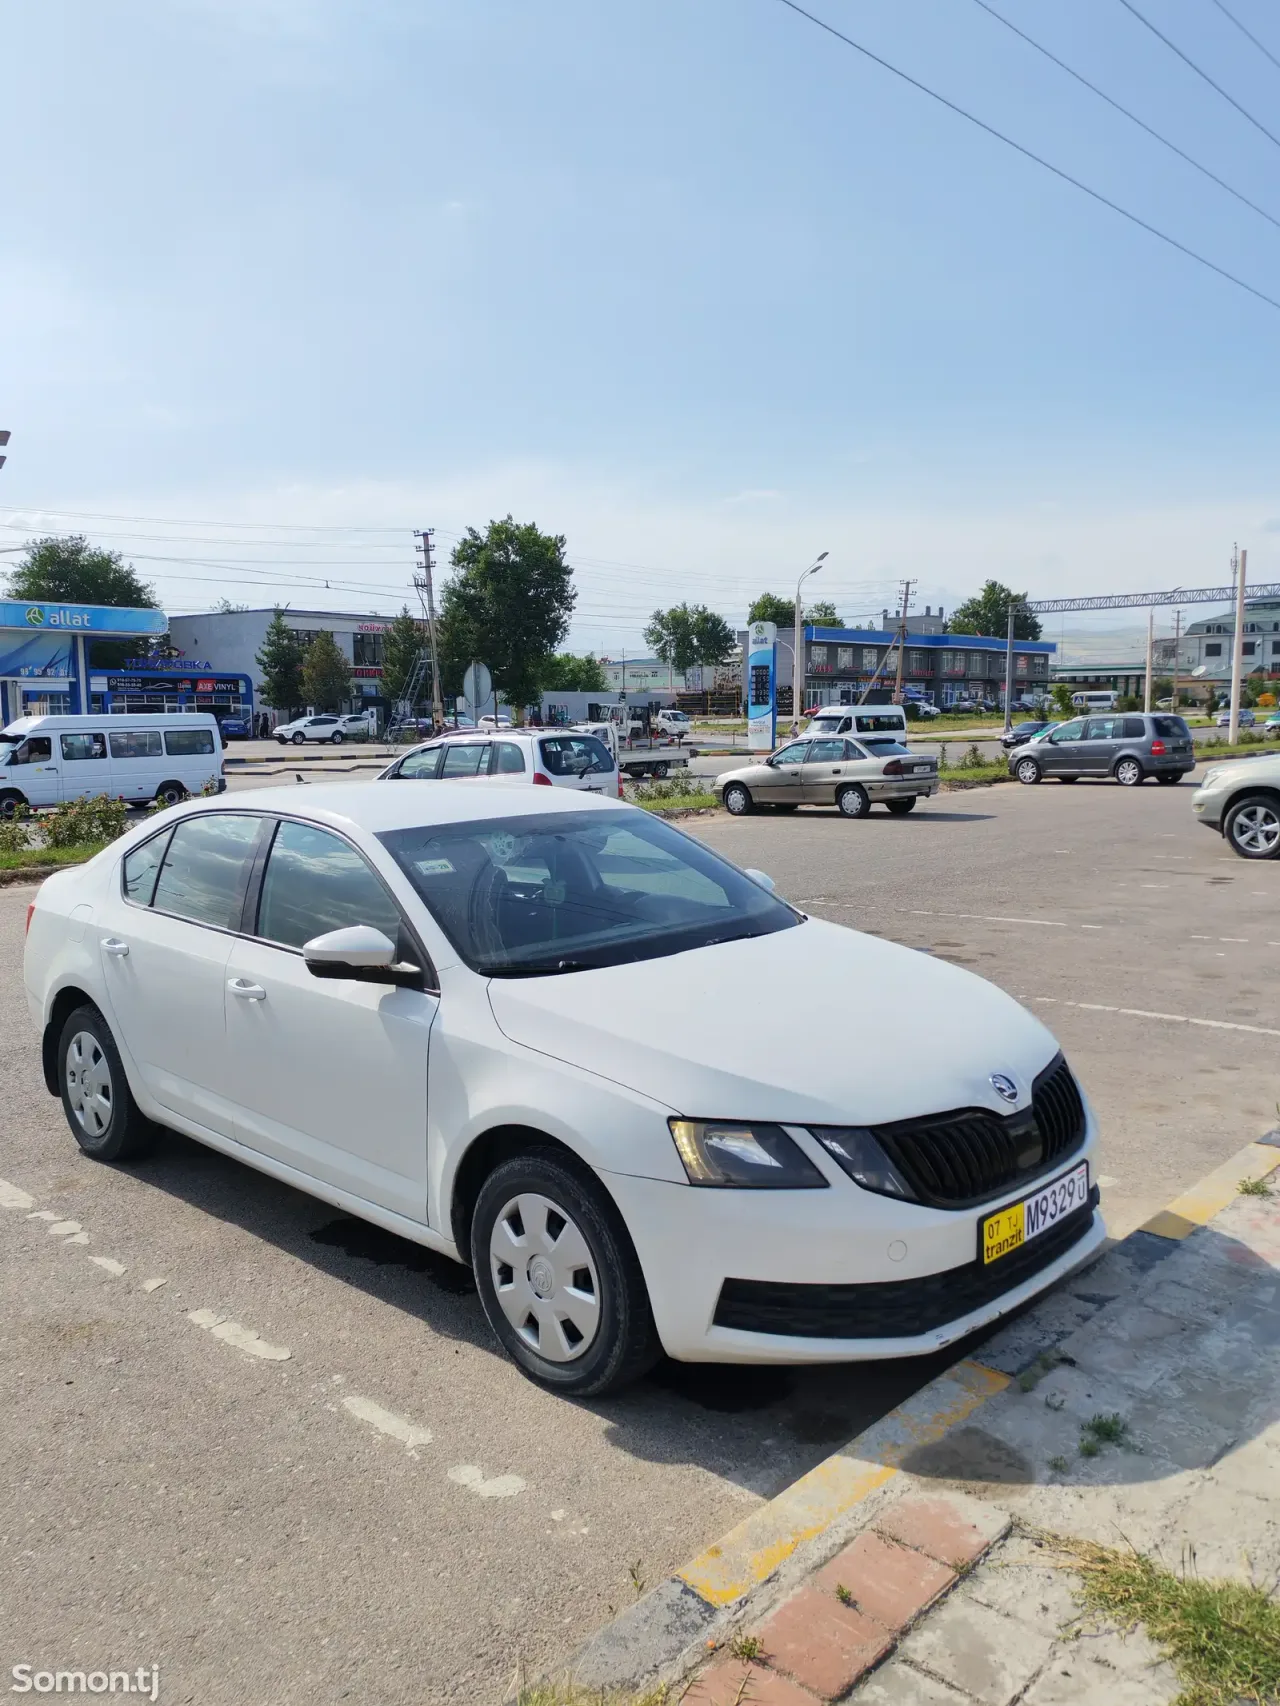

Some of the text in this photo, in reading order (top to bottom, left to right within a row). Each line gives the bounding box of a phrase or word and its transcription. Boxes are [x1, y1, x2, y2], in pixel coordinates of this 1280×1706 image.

[49, 609, 91, 627] allat
[214, 683, 236, 691] VINYL
[1026, 1177, 1075, 1236] M9329
[988, 1213, 1018, 1239] 07 TJ
[986, 1228, 1022, 1259] tranzit
